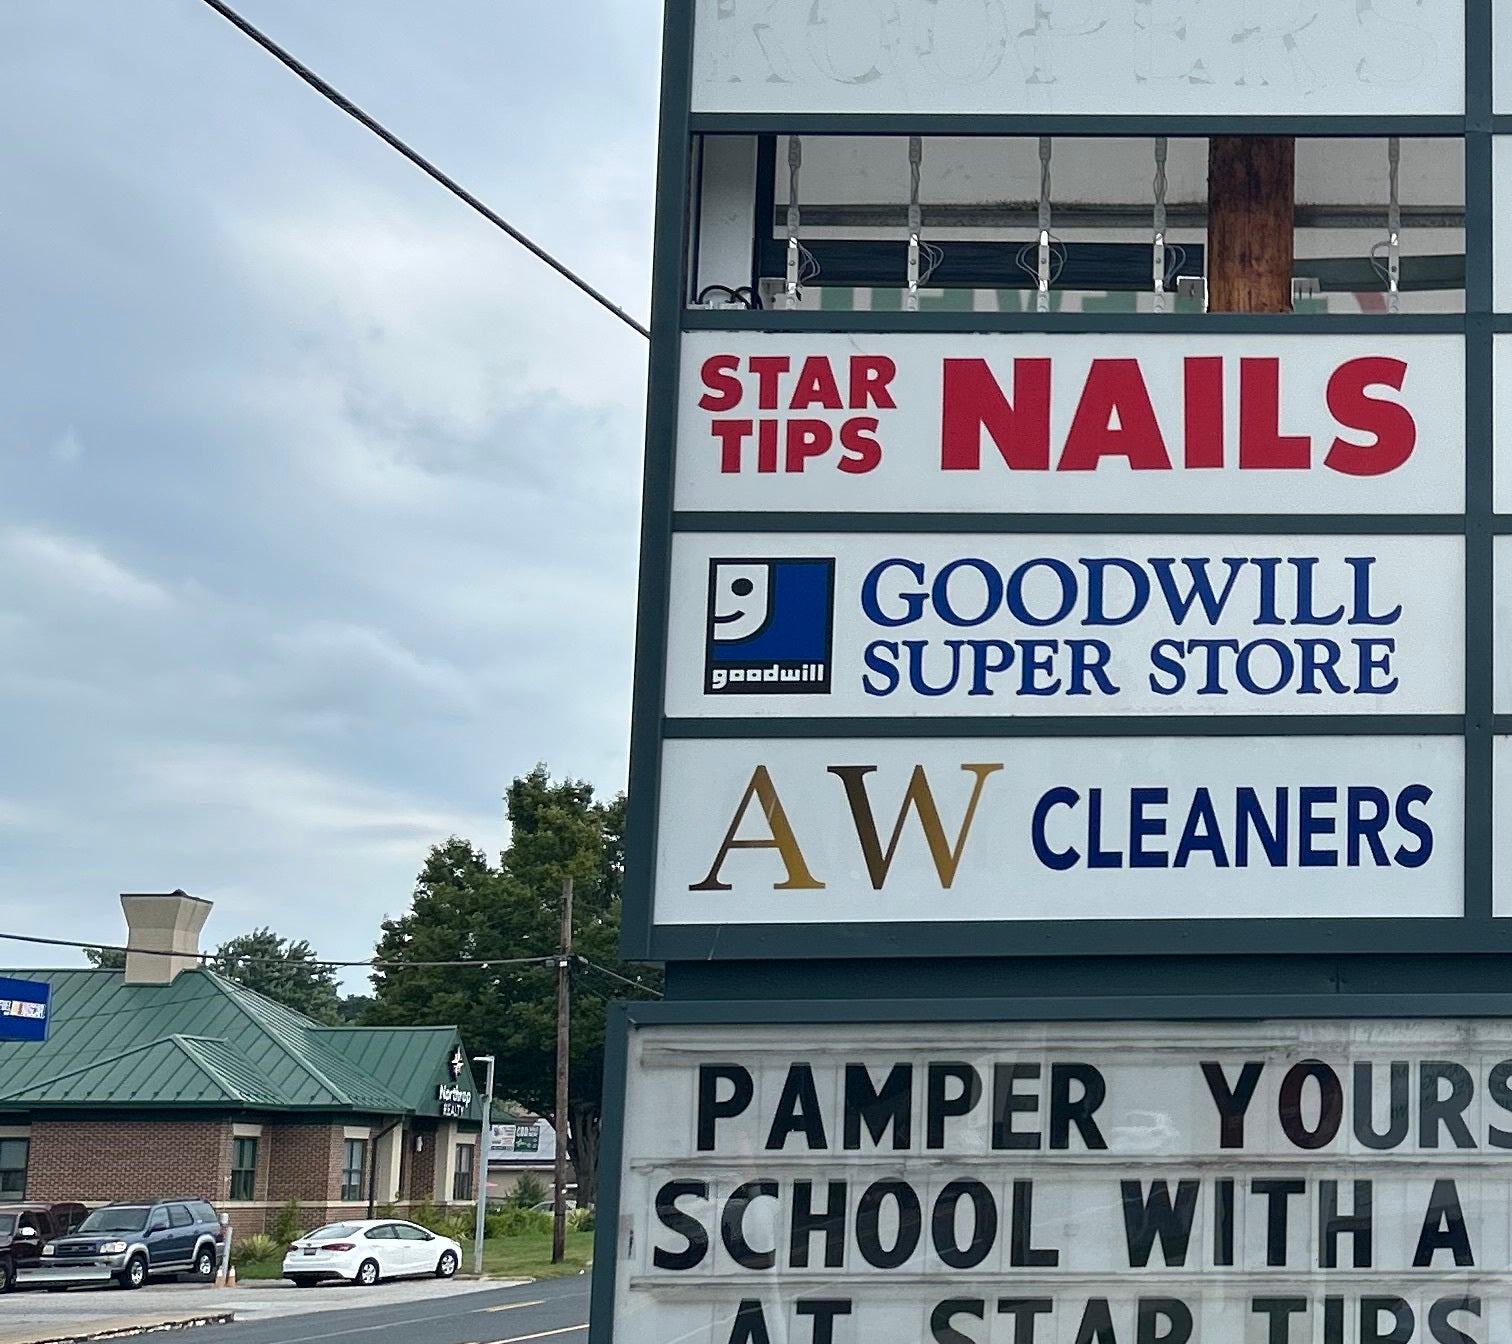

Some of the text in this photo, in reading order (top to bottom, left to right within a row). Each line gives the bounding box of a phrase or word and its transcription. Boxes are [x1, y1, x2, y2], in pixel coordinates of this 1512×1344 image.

[698, 355, 897, 412] STAR
[941, 356, 1416, 476] NAILS
[711, 417, 882, 474] TIPS
[861, 557, 1402, 627] GOODWILL
[713, 665, 823, 688] goodwill
[862, 638, 1398, 696] SUPER STORE
[689, 763, 1433, 891] AW CLEANERS
[695, 1061, 1109, 1151] PAMPER
[652, 1177, 1060, 1270] SCHOOL
[1120, 1177, 1373, 1269] WITH
[1411, 1178, 1475, 1267] A
